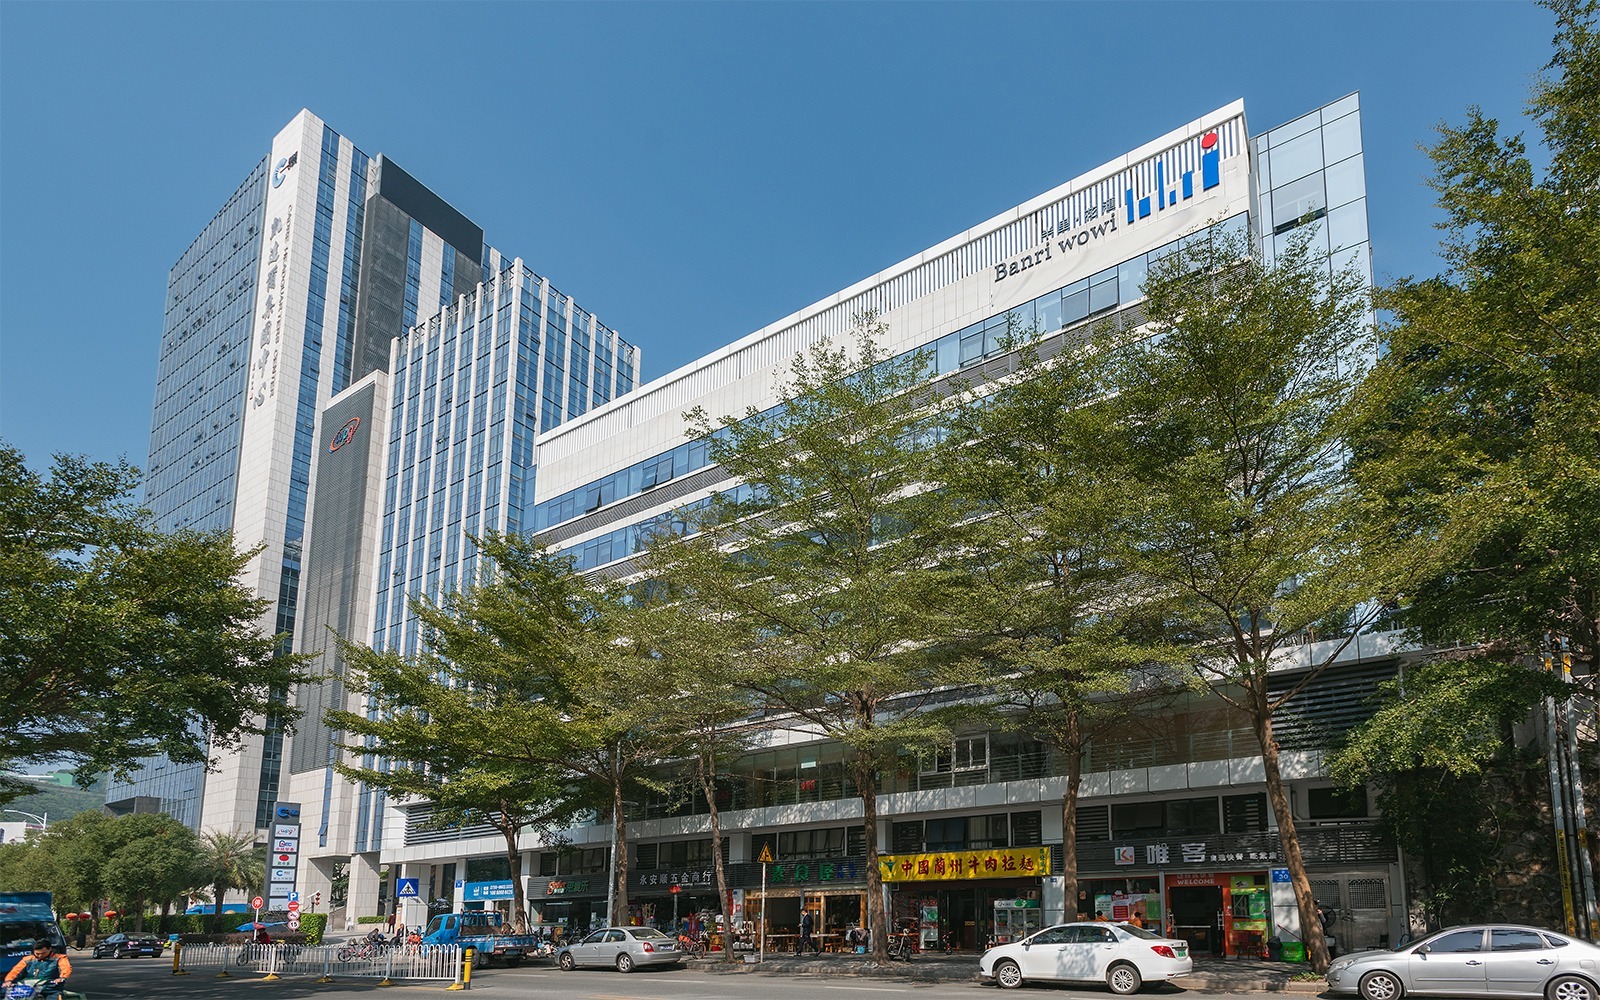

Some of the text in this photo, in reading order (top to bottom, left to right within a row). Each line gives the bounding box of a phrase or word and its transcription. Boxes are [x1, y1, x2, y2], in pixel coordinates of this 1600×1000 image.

[994, 213, 1117, 283] Banri wowi
[1146, 843, 1206, 864] 唯客
[290, 893, 298, 901] P
